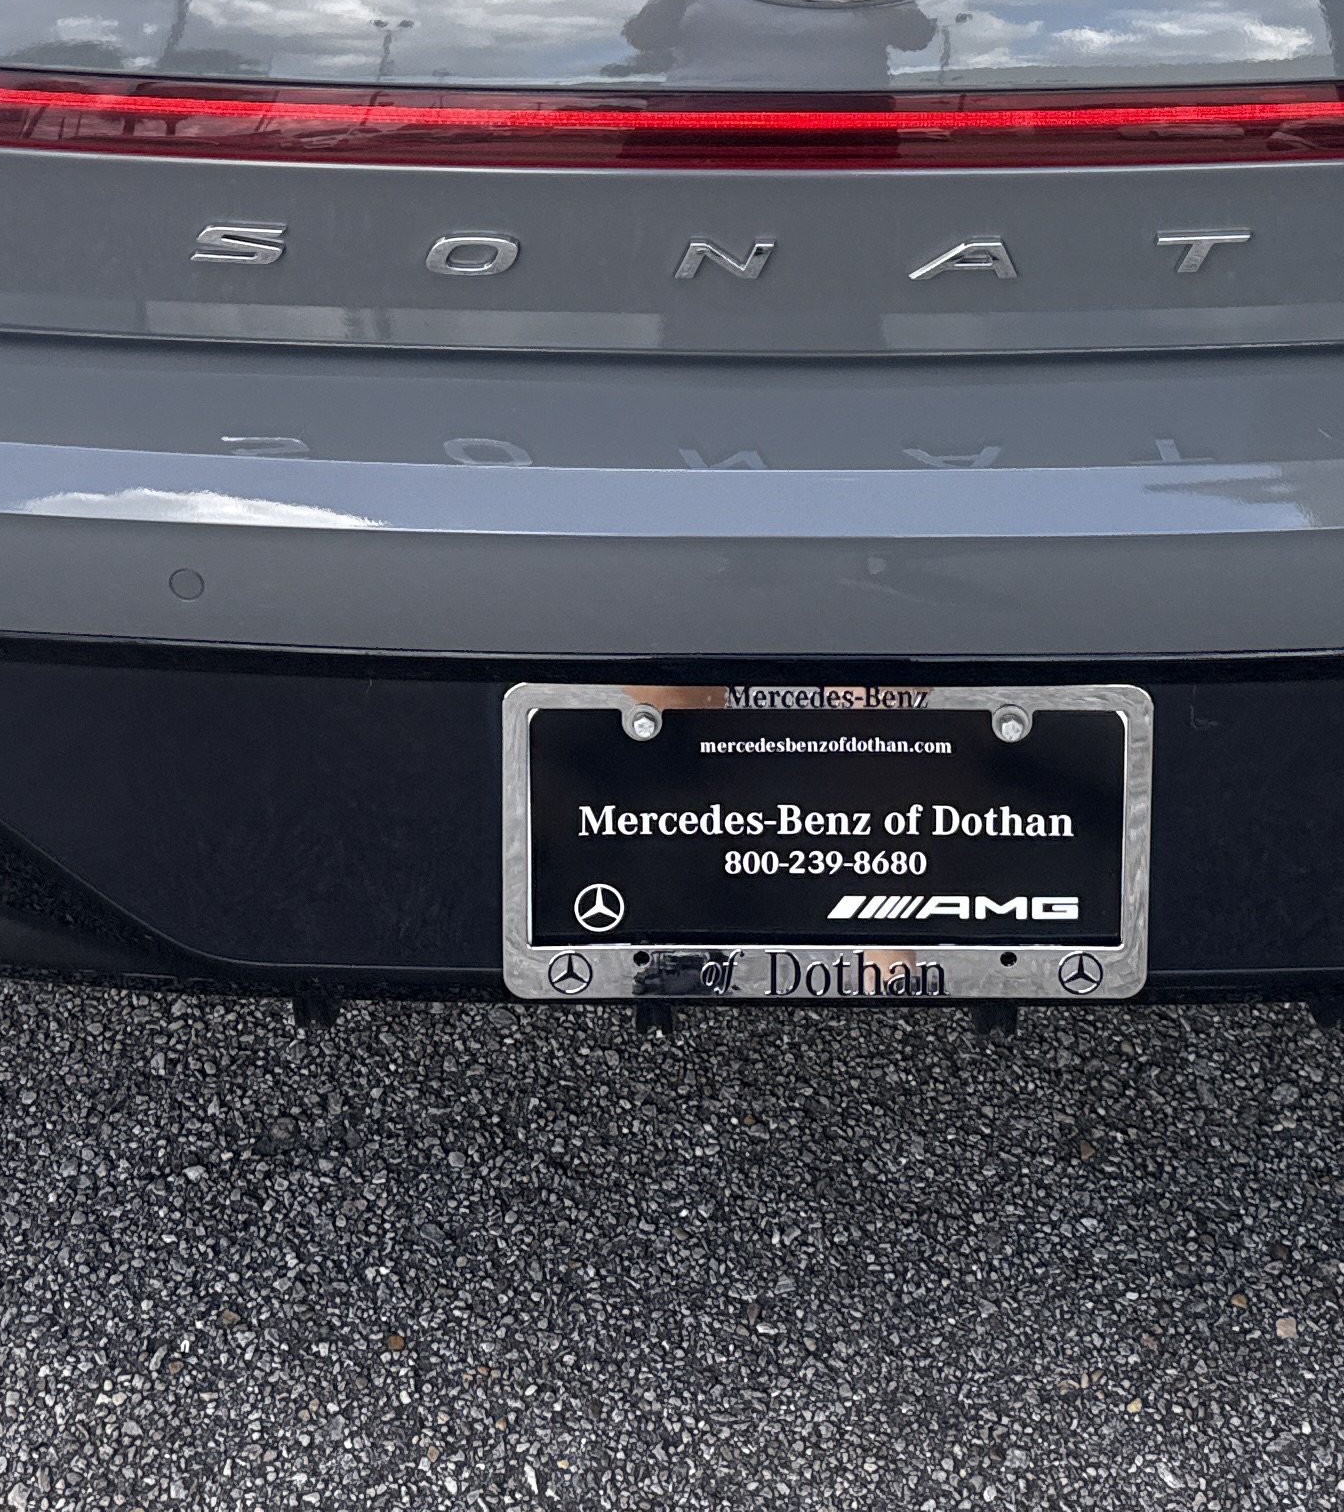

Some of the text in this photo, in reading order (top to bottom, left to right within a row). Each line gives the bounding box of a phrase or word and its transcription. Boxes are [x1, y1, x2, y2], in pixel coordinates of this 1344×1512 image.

[725, 685, 930, 710] Mercedes-Benz
[699, 736, 953, 755] mercedesbenzofdothan.com
[578, 804, 1075, 838] Mercedes-Benz of Dothan
[723, 850, 928, 876] 800-239-8680
[700, 948, 950, 997] of Dothan
